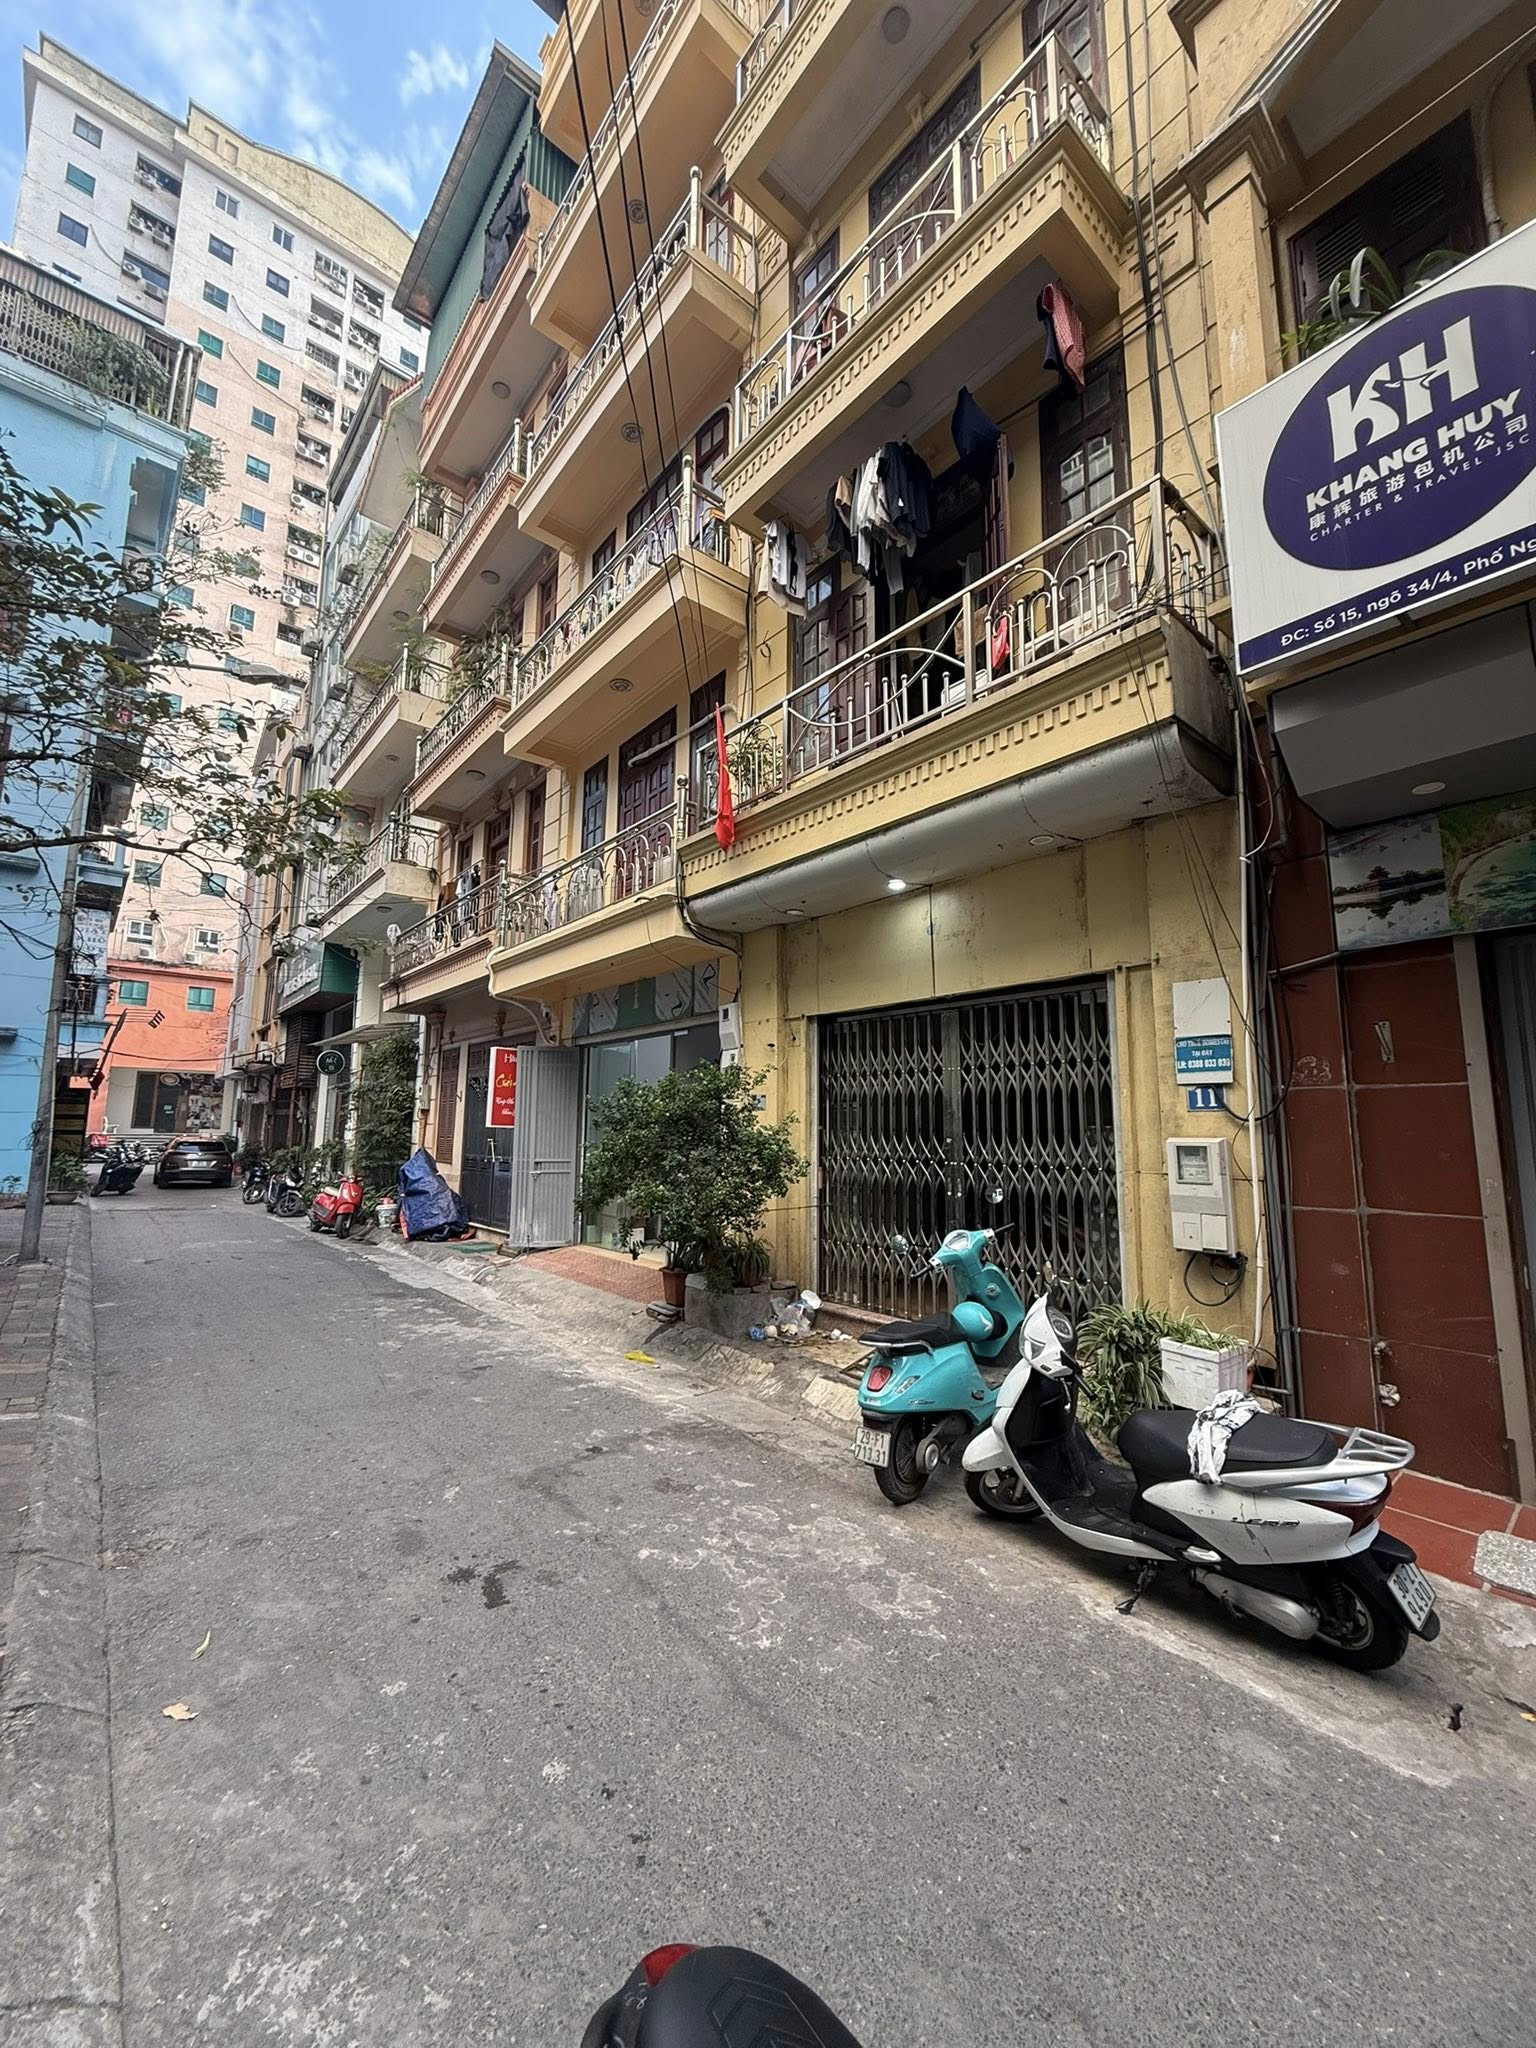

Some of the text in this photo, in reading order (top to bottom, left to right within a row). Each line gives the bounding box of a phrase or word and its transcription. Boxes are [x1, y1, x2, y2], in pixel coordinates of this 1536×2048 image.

[1327, 316, 1479, 463] KH
[1306, 388, 1521, 513] KHANG HUY
[1309, 414, 1527, 530] 康辉旅游包机公司
[1310, 433, 1530, 542] CHARTER & TRAVEL JSC
[1281, 628, 1310, 647] ĐC:
[1314, 614, 1336, 633] Số
[1340, 606, 1362, 622] 15,
[1367, 591, 1402, 615] ngõ
[1407, 572, 1458, 598] 34/4,
[1463, 547, 1503, 575] Phố
[1195, 1088, 1218, 1107] 11
[860, 1430, 885, 1449] 29-F1
[1407, 1581, 1432, 1621] 9490
